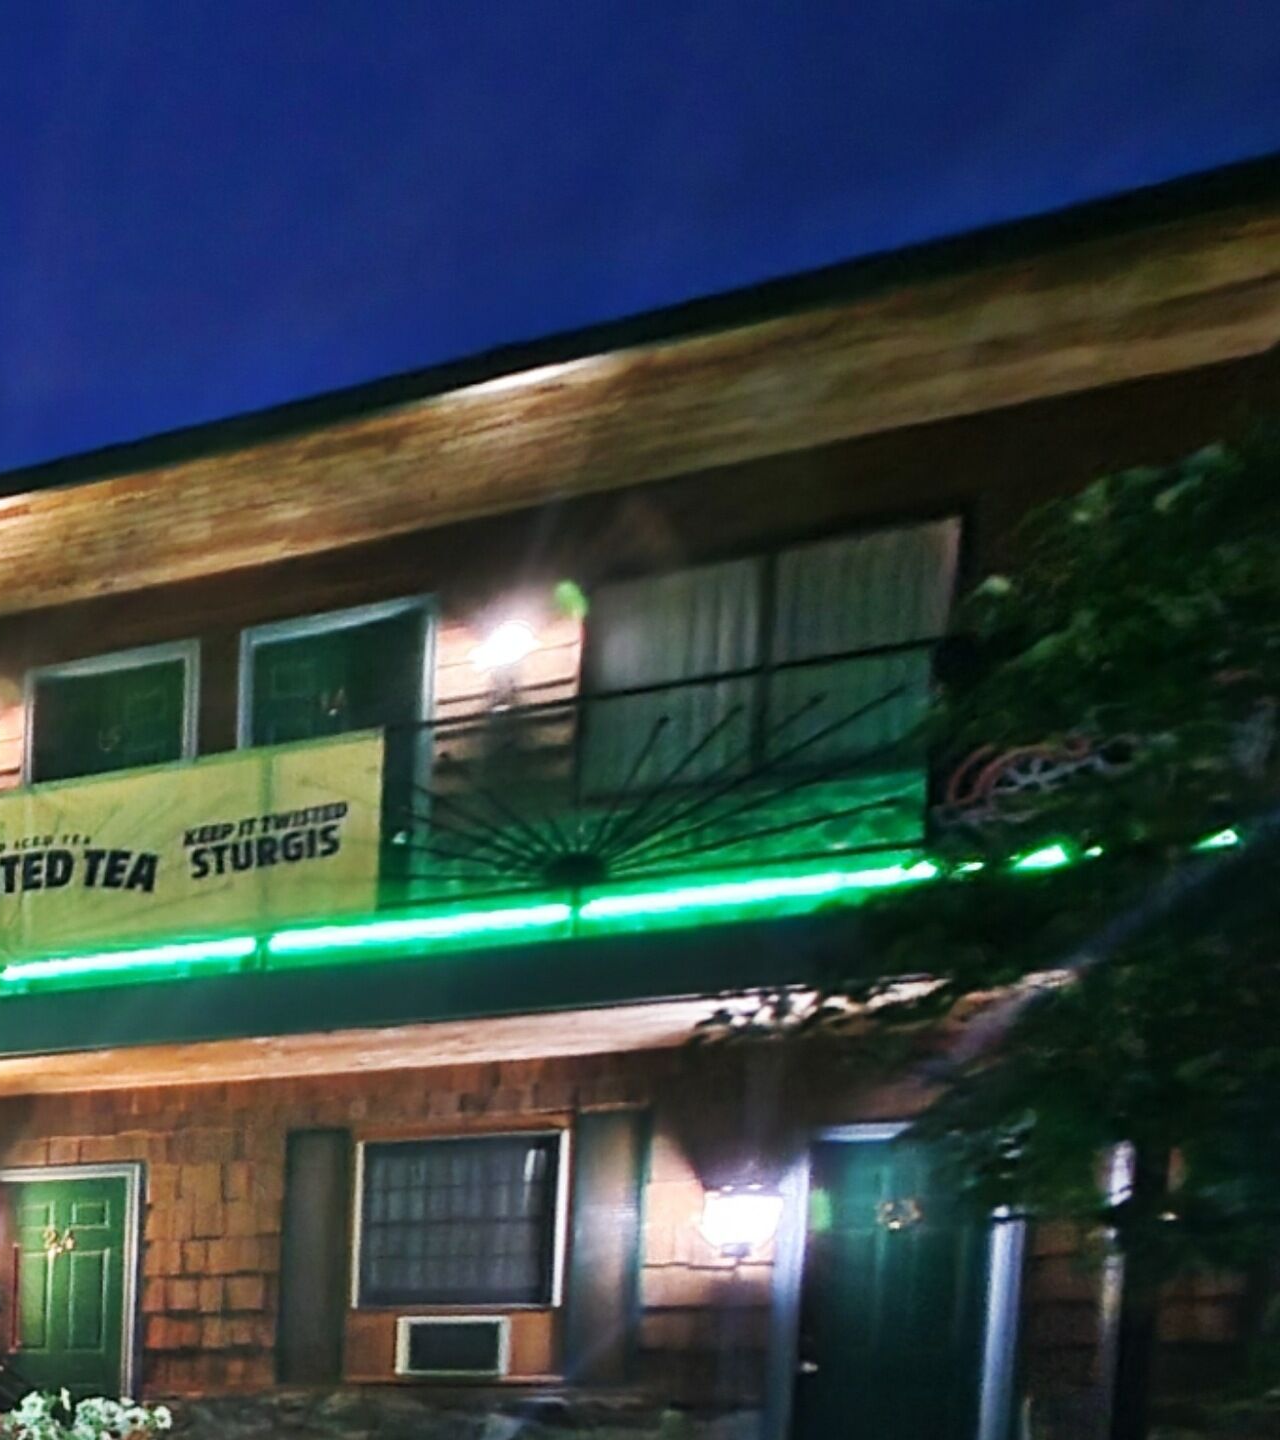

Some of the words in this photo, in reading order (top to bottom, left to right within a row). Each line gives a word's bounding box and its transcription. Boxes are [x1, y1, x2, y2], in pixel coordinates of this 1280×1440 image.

[184, 824, 236, 848] KEEP
[237, 819, 258, 836] IT
[260, 802, 349, 833] TWISTED
[83, 850, 161, 893] TEA
[190, 824, 340, 880] STURGIS
